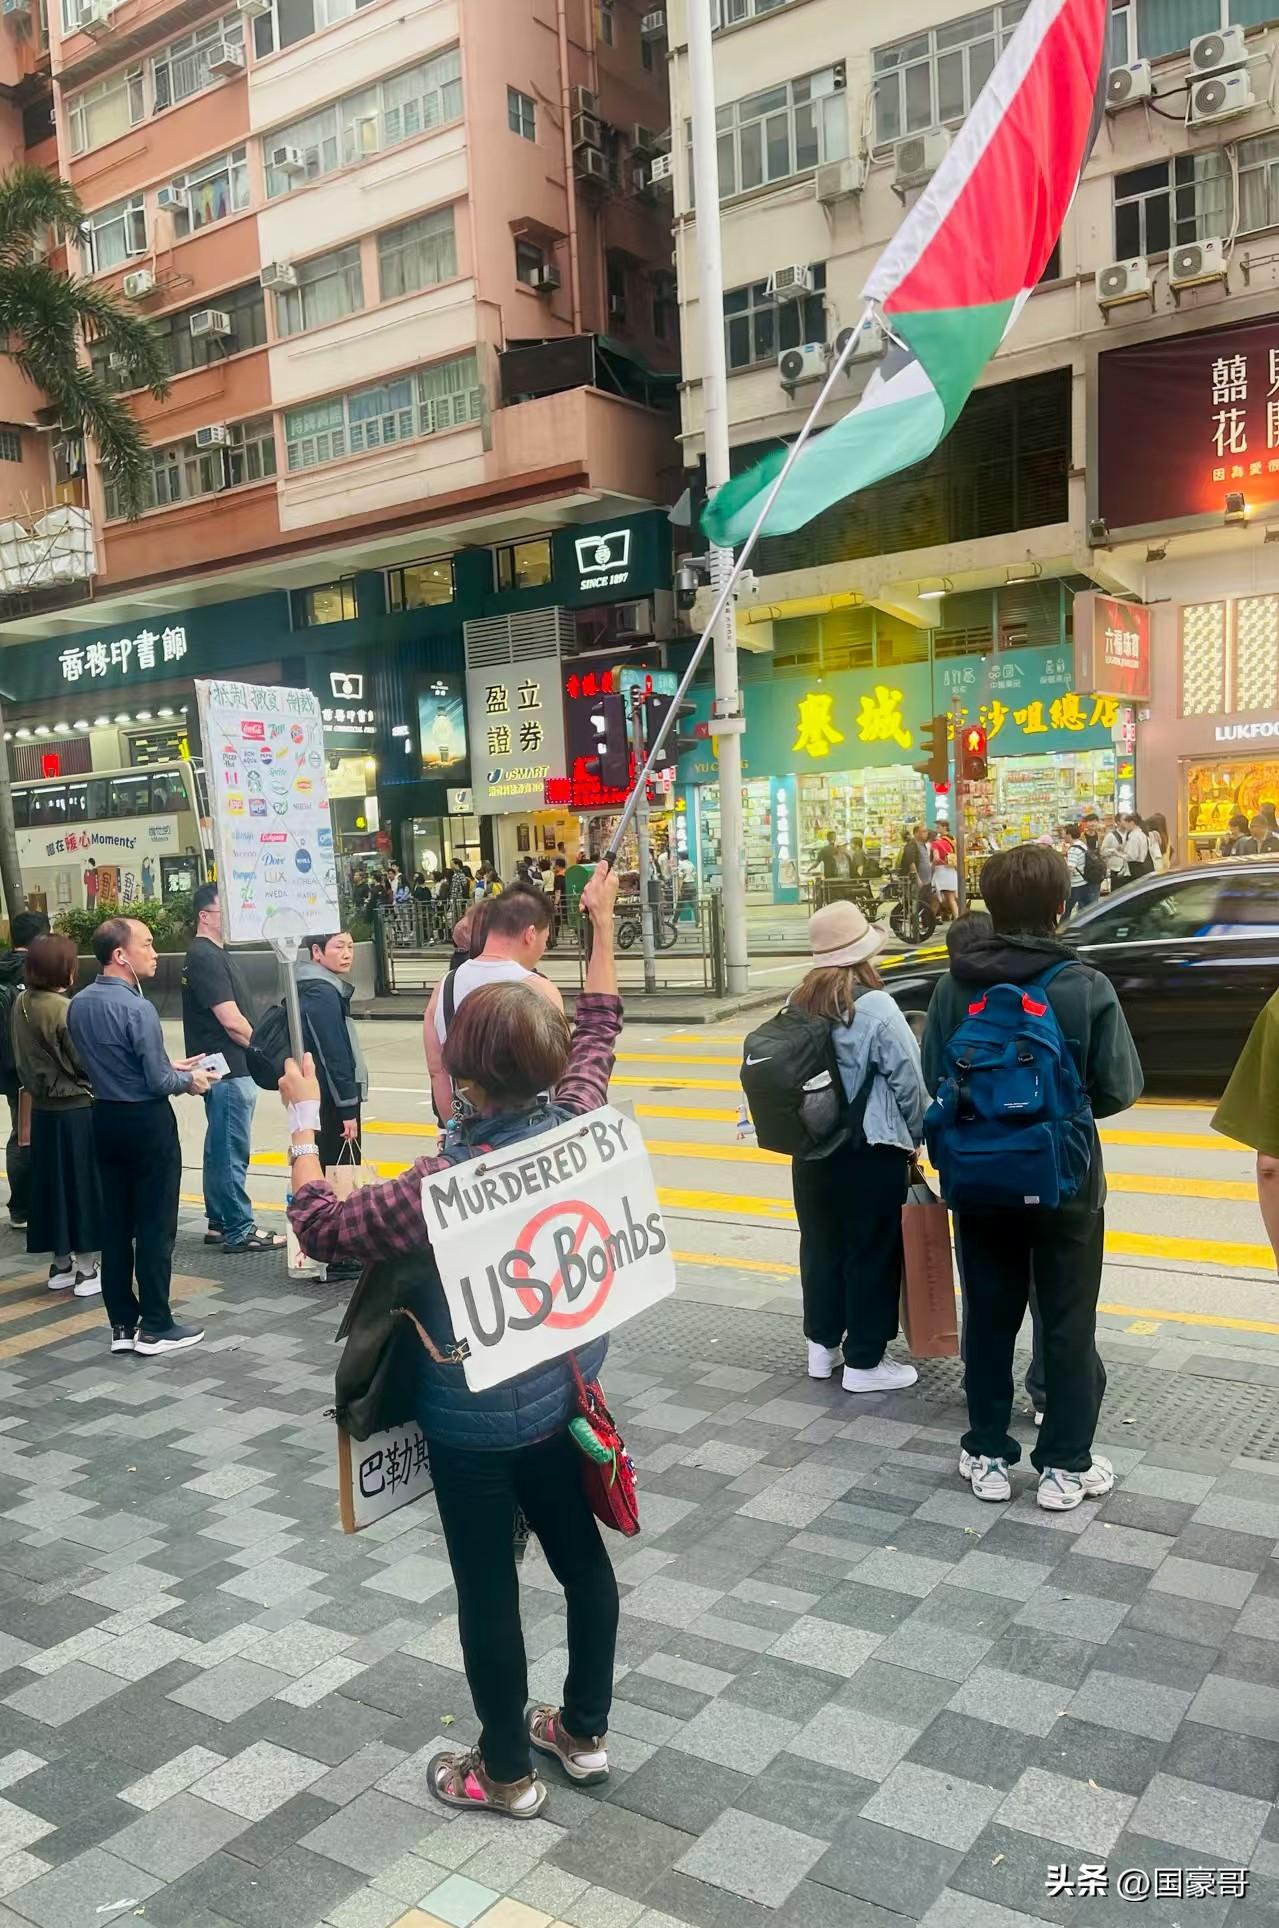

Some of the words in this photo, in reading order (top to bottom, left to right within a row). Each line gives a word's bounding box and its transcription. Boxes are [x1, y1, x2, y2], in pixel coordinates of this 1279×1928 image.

[580, 575, 608, 590] SINCE
[609, 572, 629, 585] 1897
[58, 626, 188, 683] 商務印書館
[485, 677, 541, 715] 盈立
[487, 720, 543, 756] 證券
[262, 853, 286, 866] Dove
[264, 871, 287, 882] LUX
[429, 1141, 588, 1230] MURDERED
[588, 1118, 630, 1163] BY
[459, 1249, 554, 1347] US
[553, 1196, 667, 1303] Bombs
